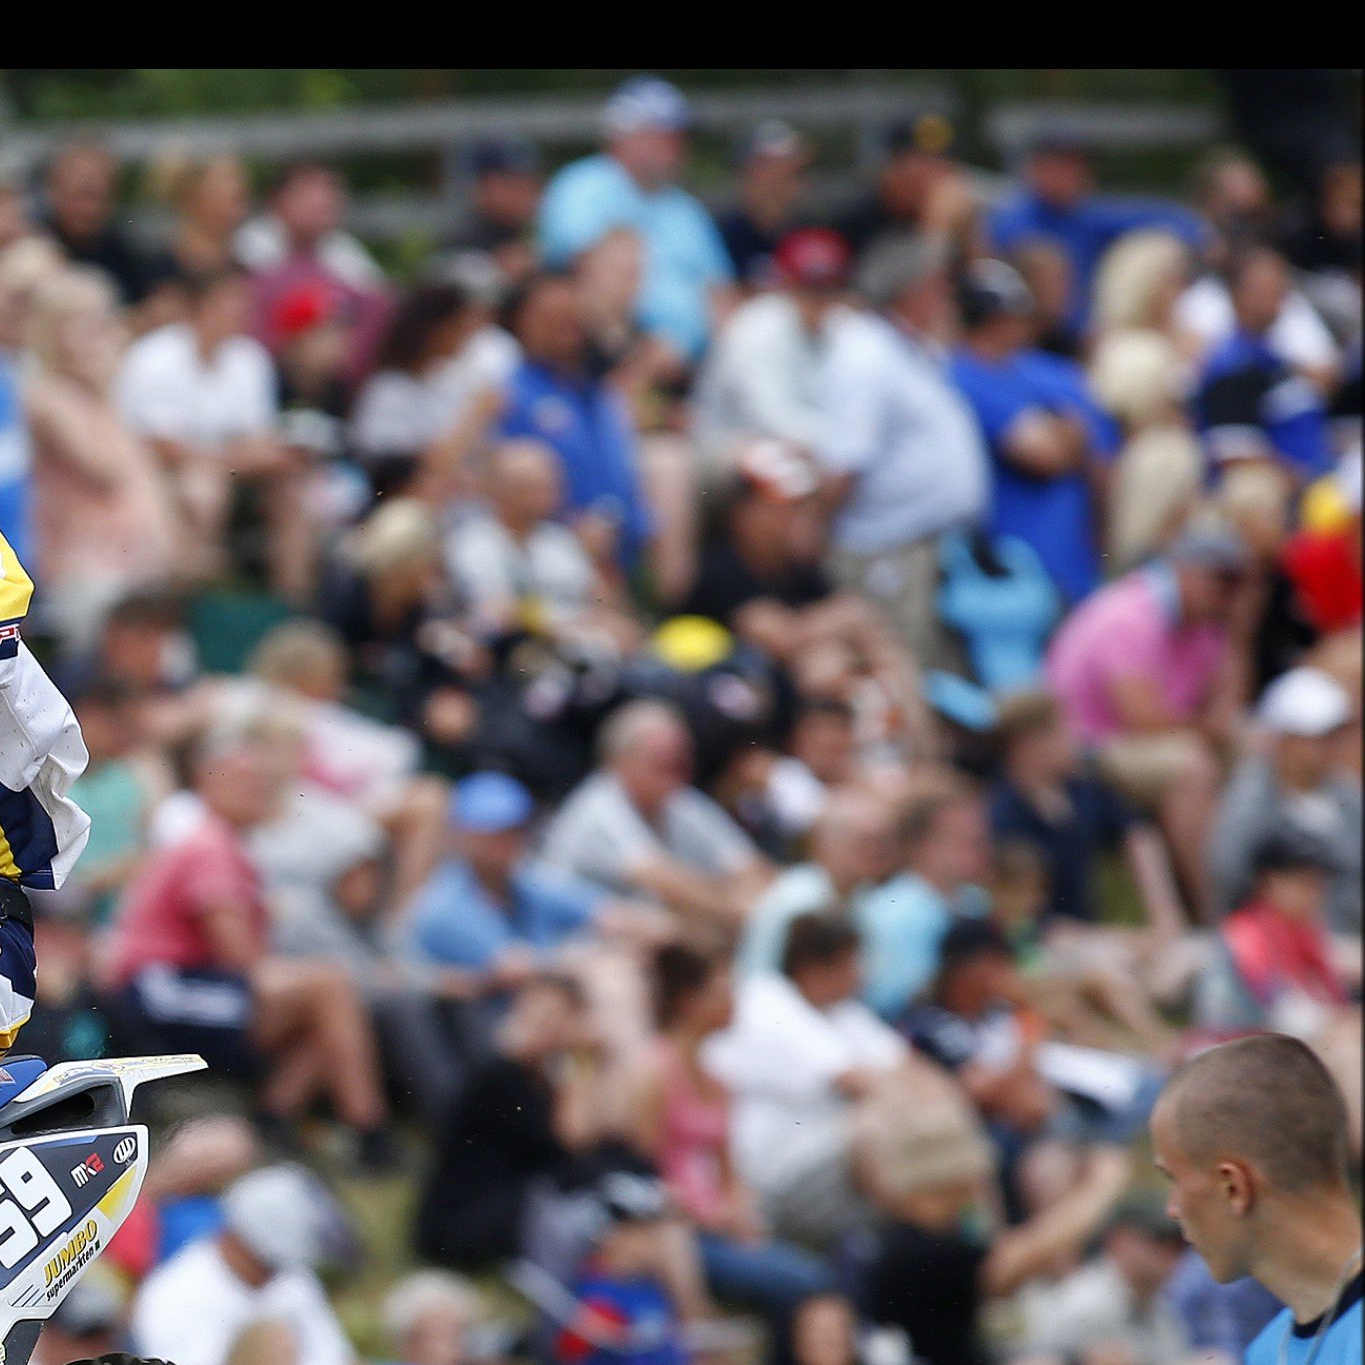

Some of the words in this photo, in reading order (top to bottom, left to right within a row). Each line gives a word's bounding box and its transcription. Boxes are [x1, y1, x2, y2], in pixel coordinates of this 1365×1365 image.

[70, 1152, 105, 1189] MX2
[43, 1219, 99, 1288] JUMBO
[45, 1245, 95, 1302] supermarkten
